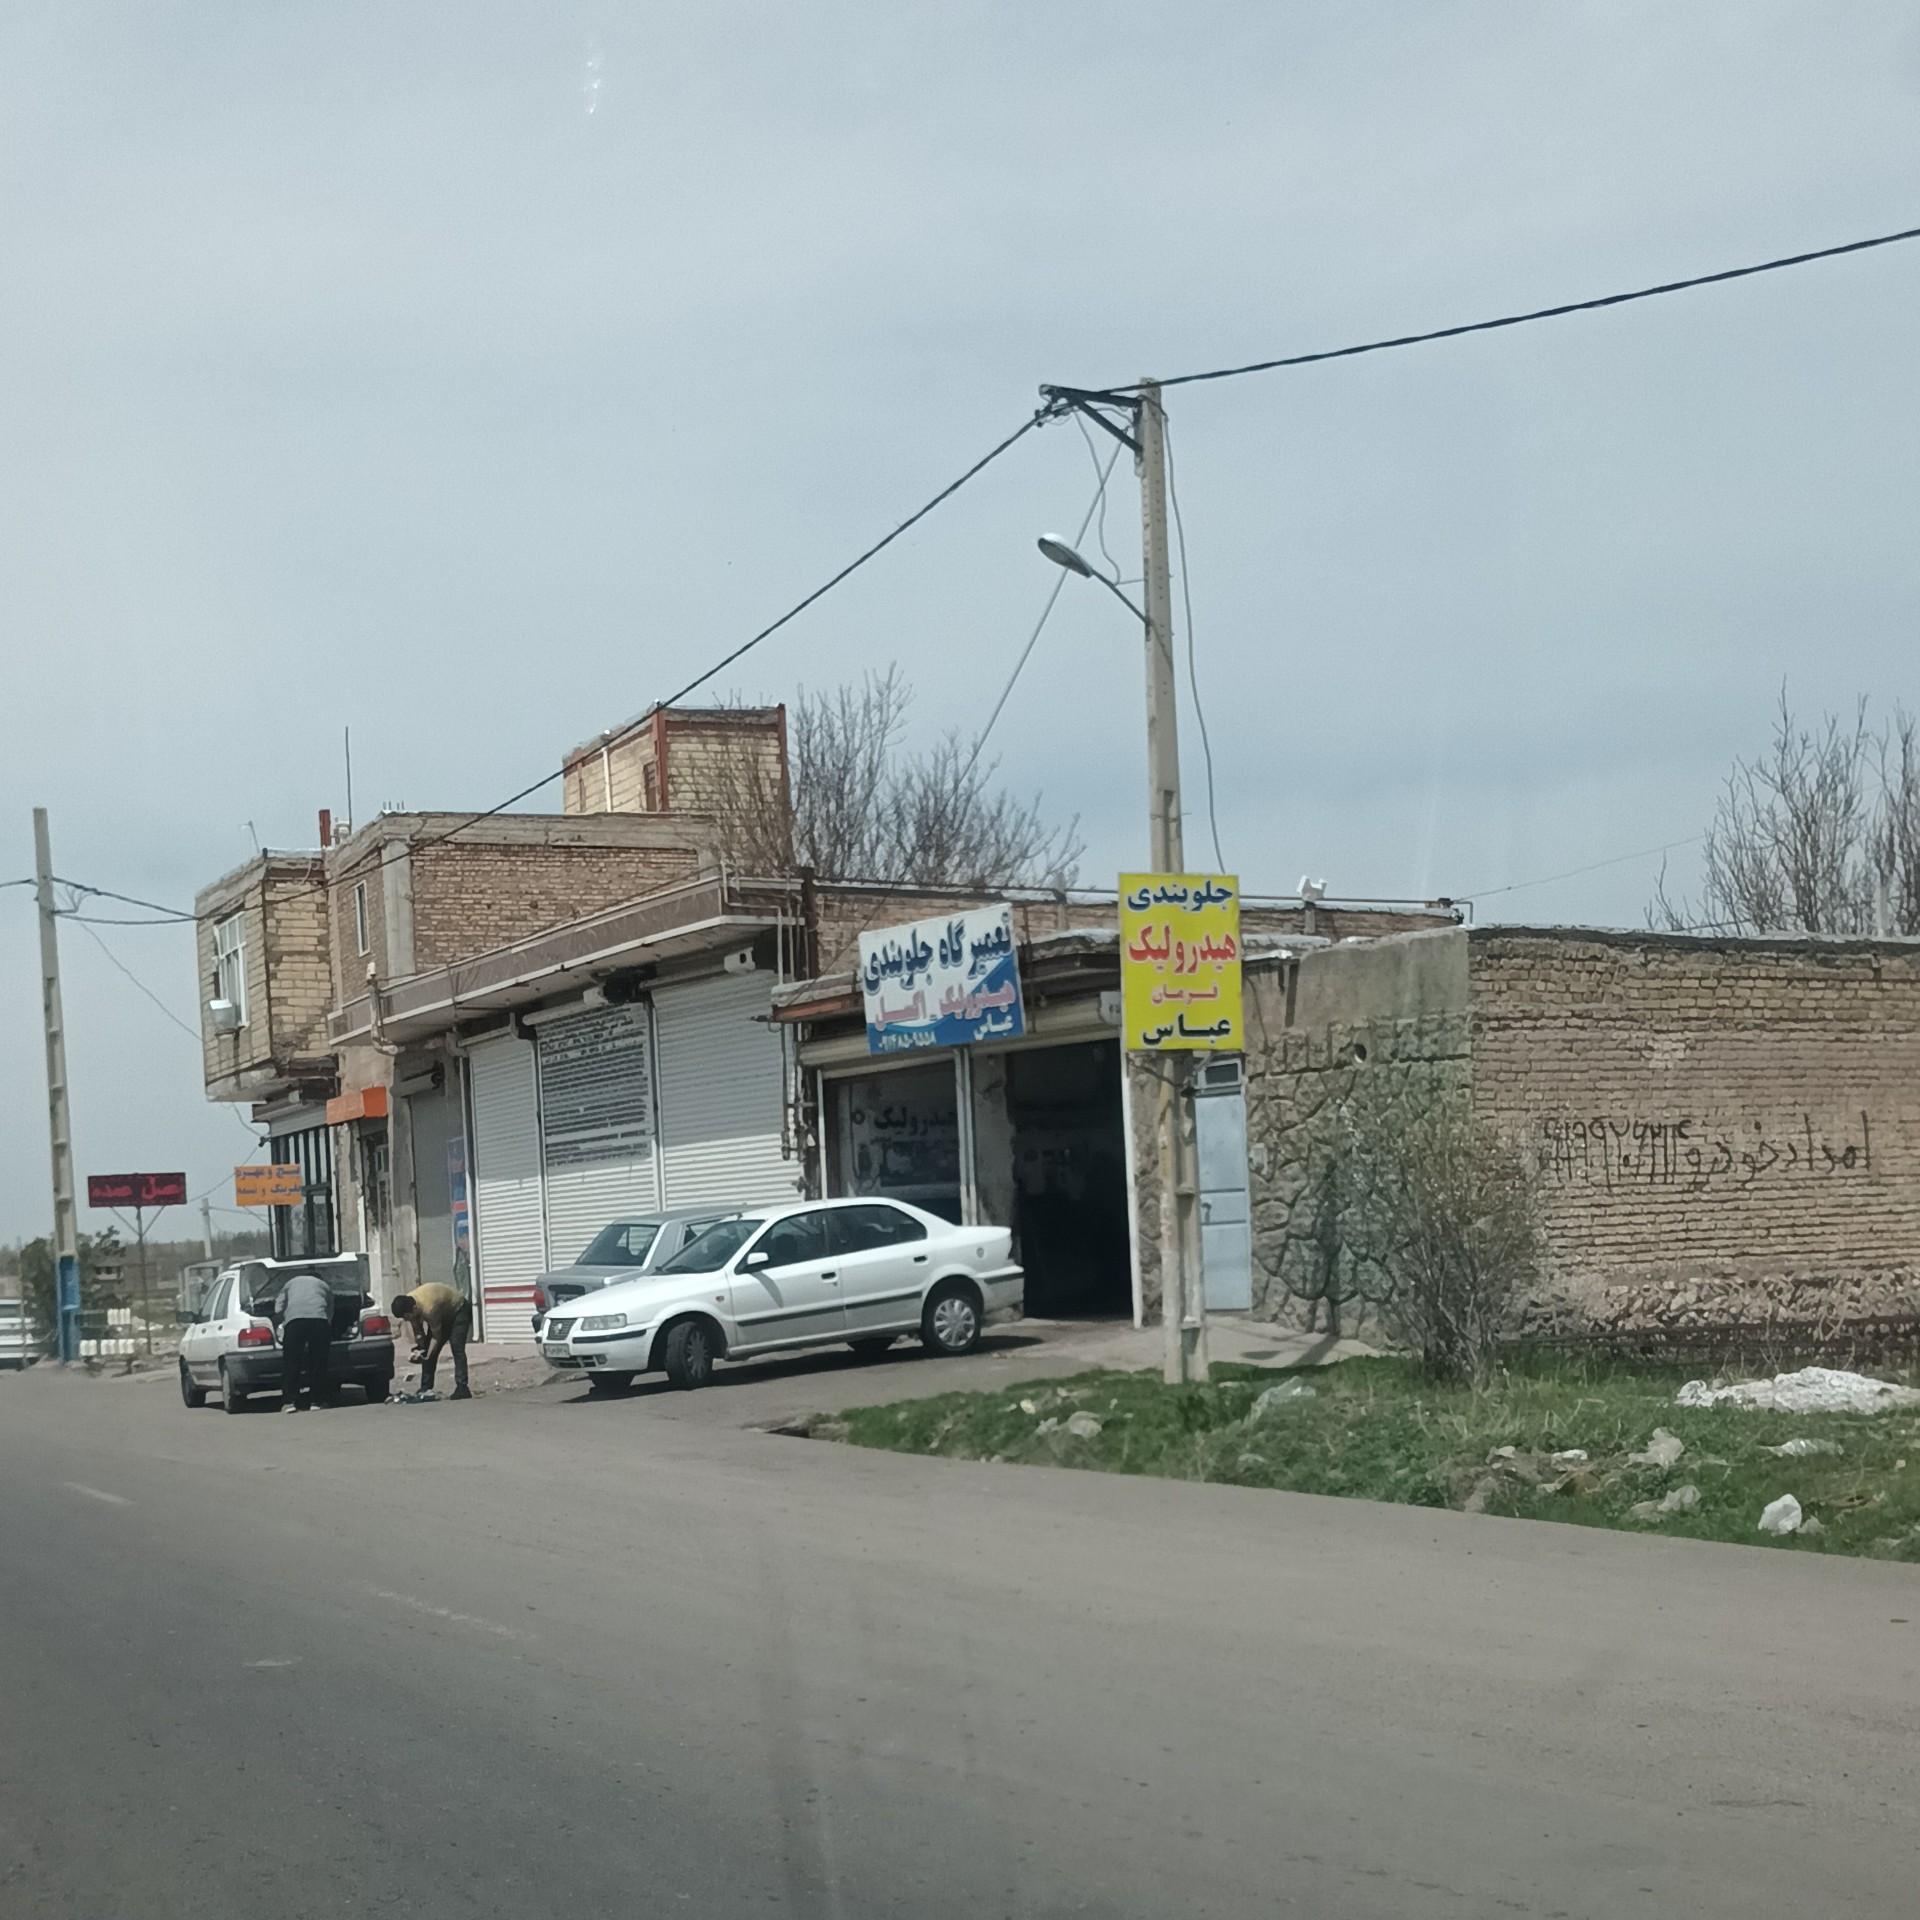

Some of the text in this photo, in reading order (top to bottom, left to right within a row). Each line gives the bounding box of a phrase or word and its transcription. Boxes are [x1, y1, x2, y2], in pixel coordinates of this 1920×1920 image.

[1127, 880, 1233, 912] جلوبندی
[864, 928, 934, 995] جلوبندی
[1128, 925, 1237, 974] هیدرولیک
[1142, 1013, 1232, 1045] عباس
